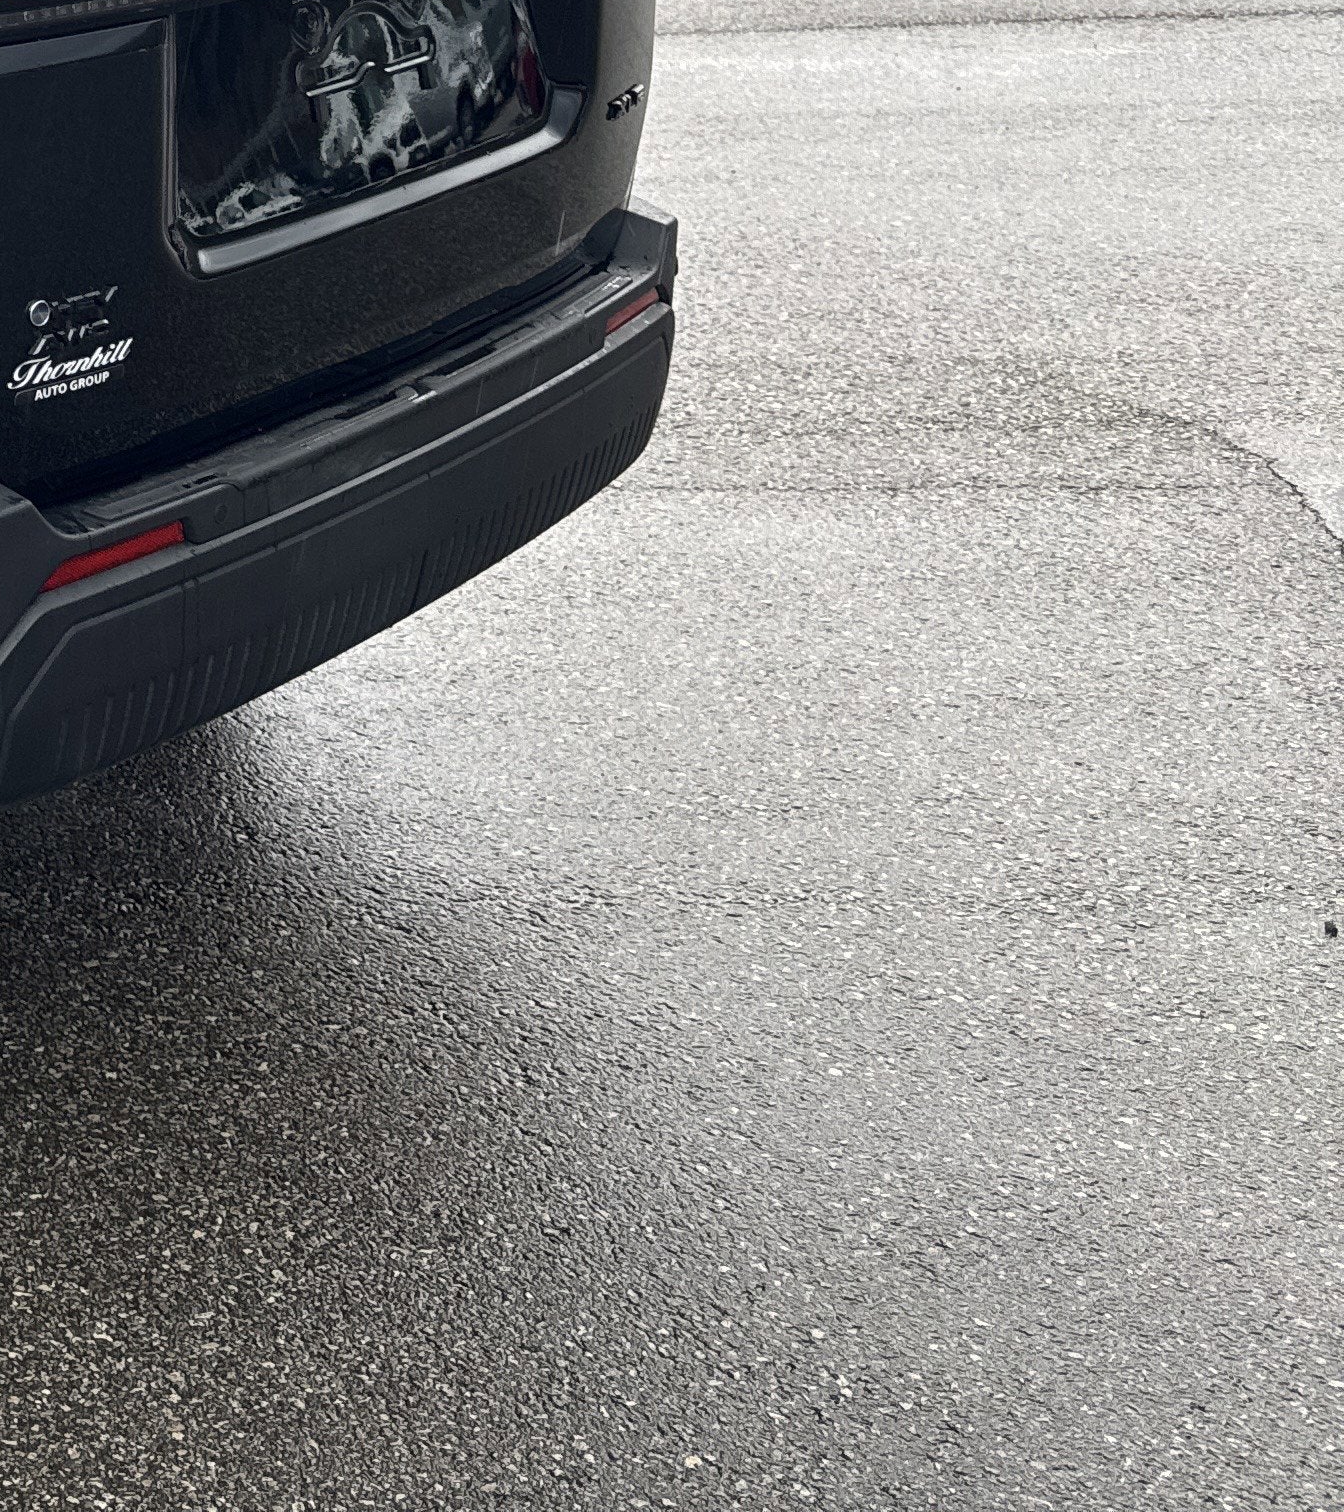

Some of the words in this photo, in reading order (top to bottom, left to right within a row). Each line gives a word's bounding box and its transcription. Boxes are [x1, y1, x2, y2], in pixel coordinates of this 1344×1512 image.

[7, 337, 133, 389] Thornhill
[34, 383, 67, 401] AUTO
[69, 370, 110, 391] GROUP
